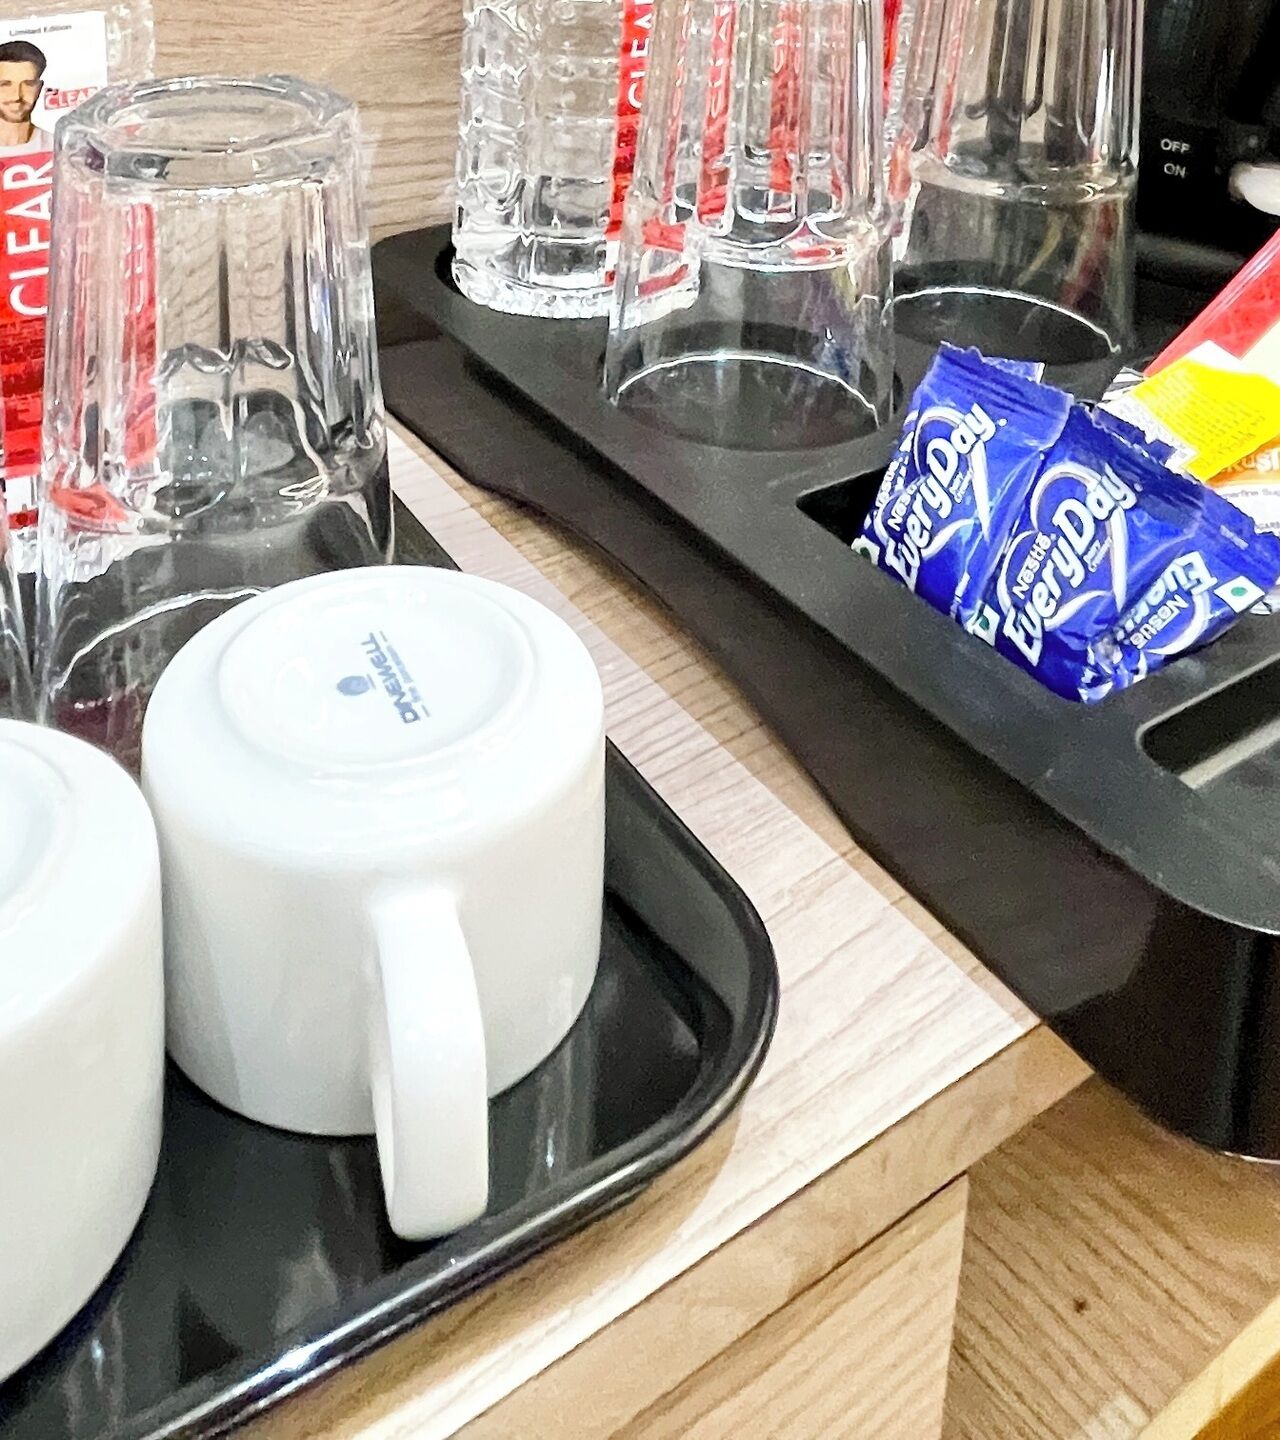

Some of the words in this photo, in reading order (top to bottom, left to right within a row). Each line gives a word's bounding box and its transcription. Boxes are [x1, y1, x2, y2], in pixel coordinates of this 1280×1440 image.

[1160, 138, 1190, 154] OFF
[1163, 163, 1187, 179] ON
[1003, 462, 1138, 667] EveryDay
[361, 632, 421, 724] DINEWELL
